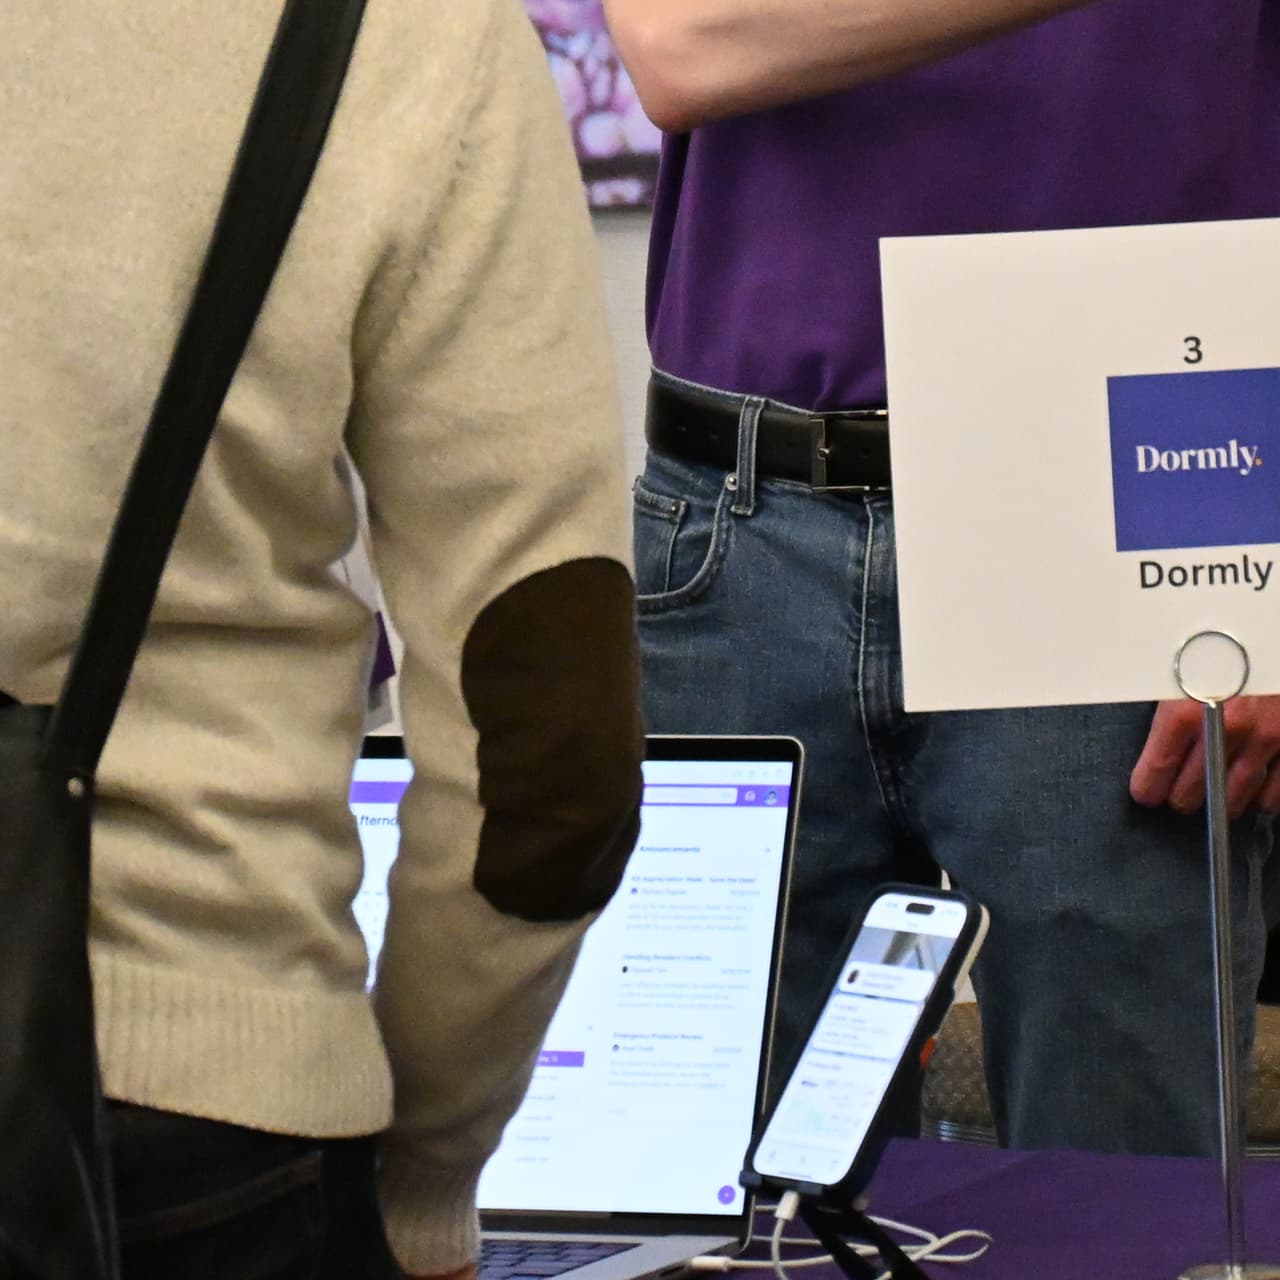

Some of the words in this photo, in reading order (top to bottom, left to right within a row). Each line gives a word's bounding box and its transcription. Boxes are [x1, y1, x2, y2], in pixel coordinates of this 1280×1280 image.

[1183, 335, 1203, 365] 3
[1135, 438, 1263, 476] Dormly.
[1139, 553, 1274, 593] Dormly
